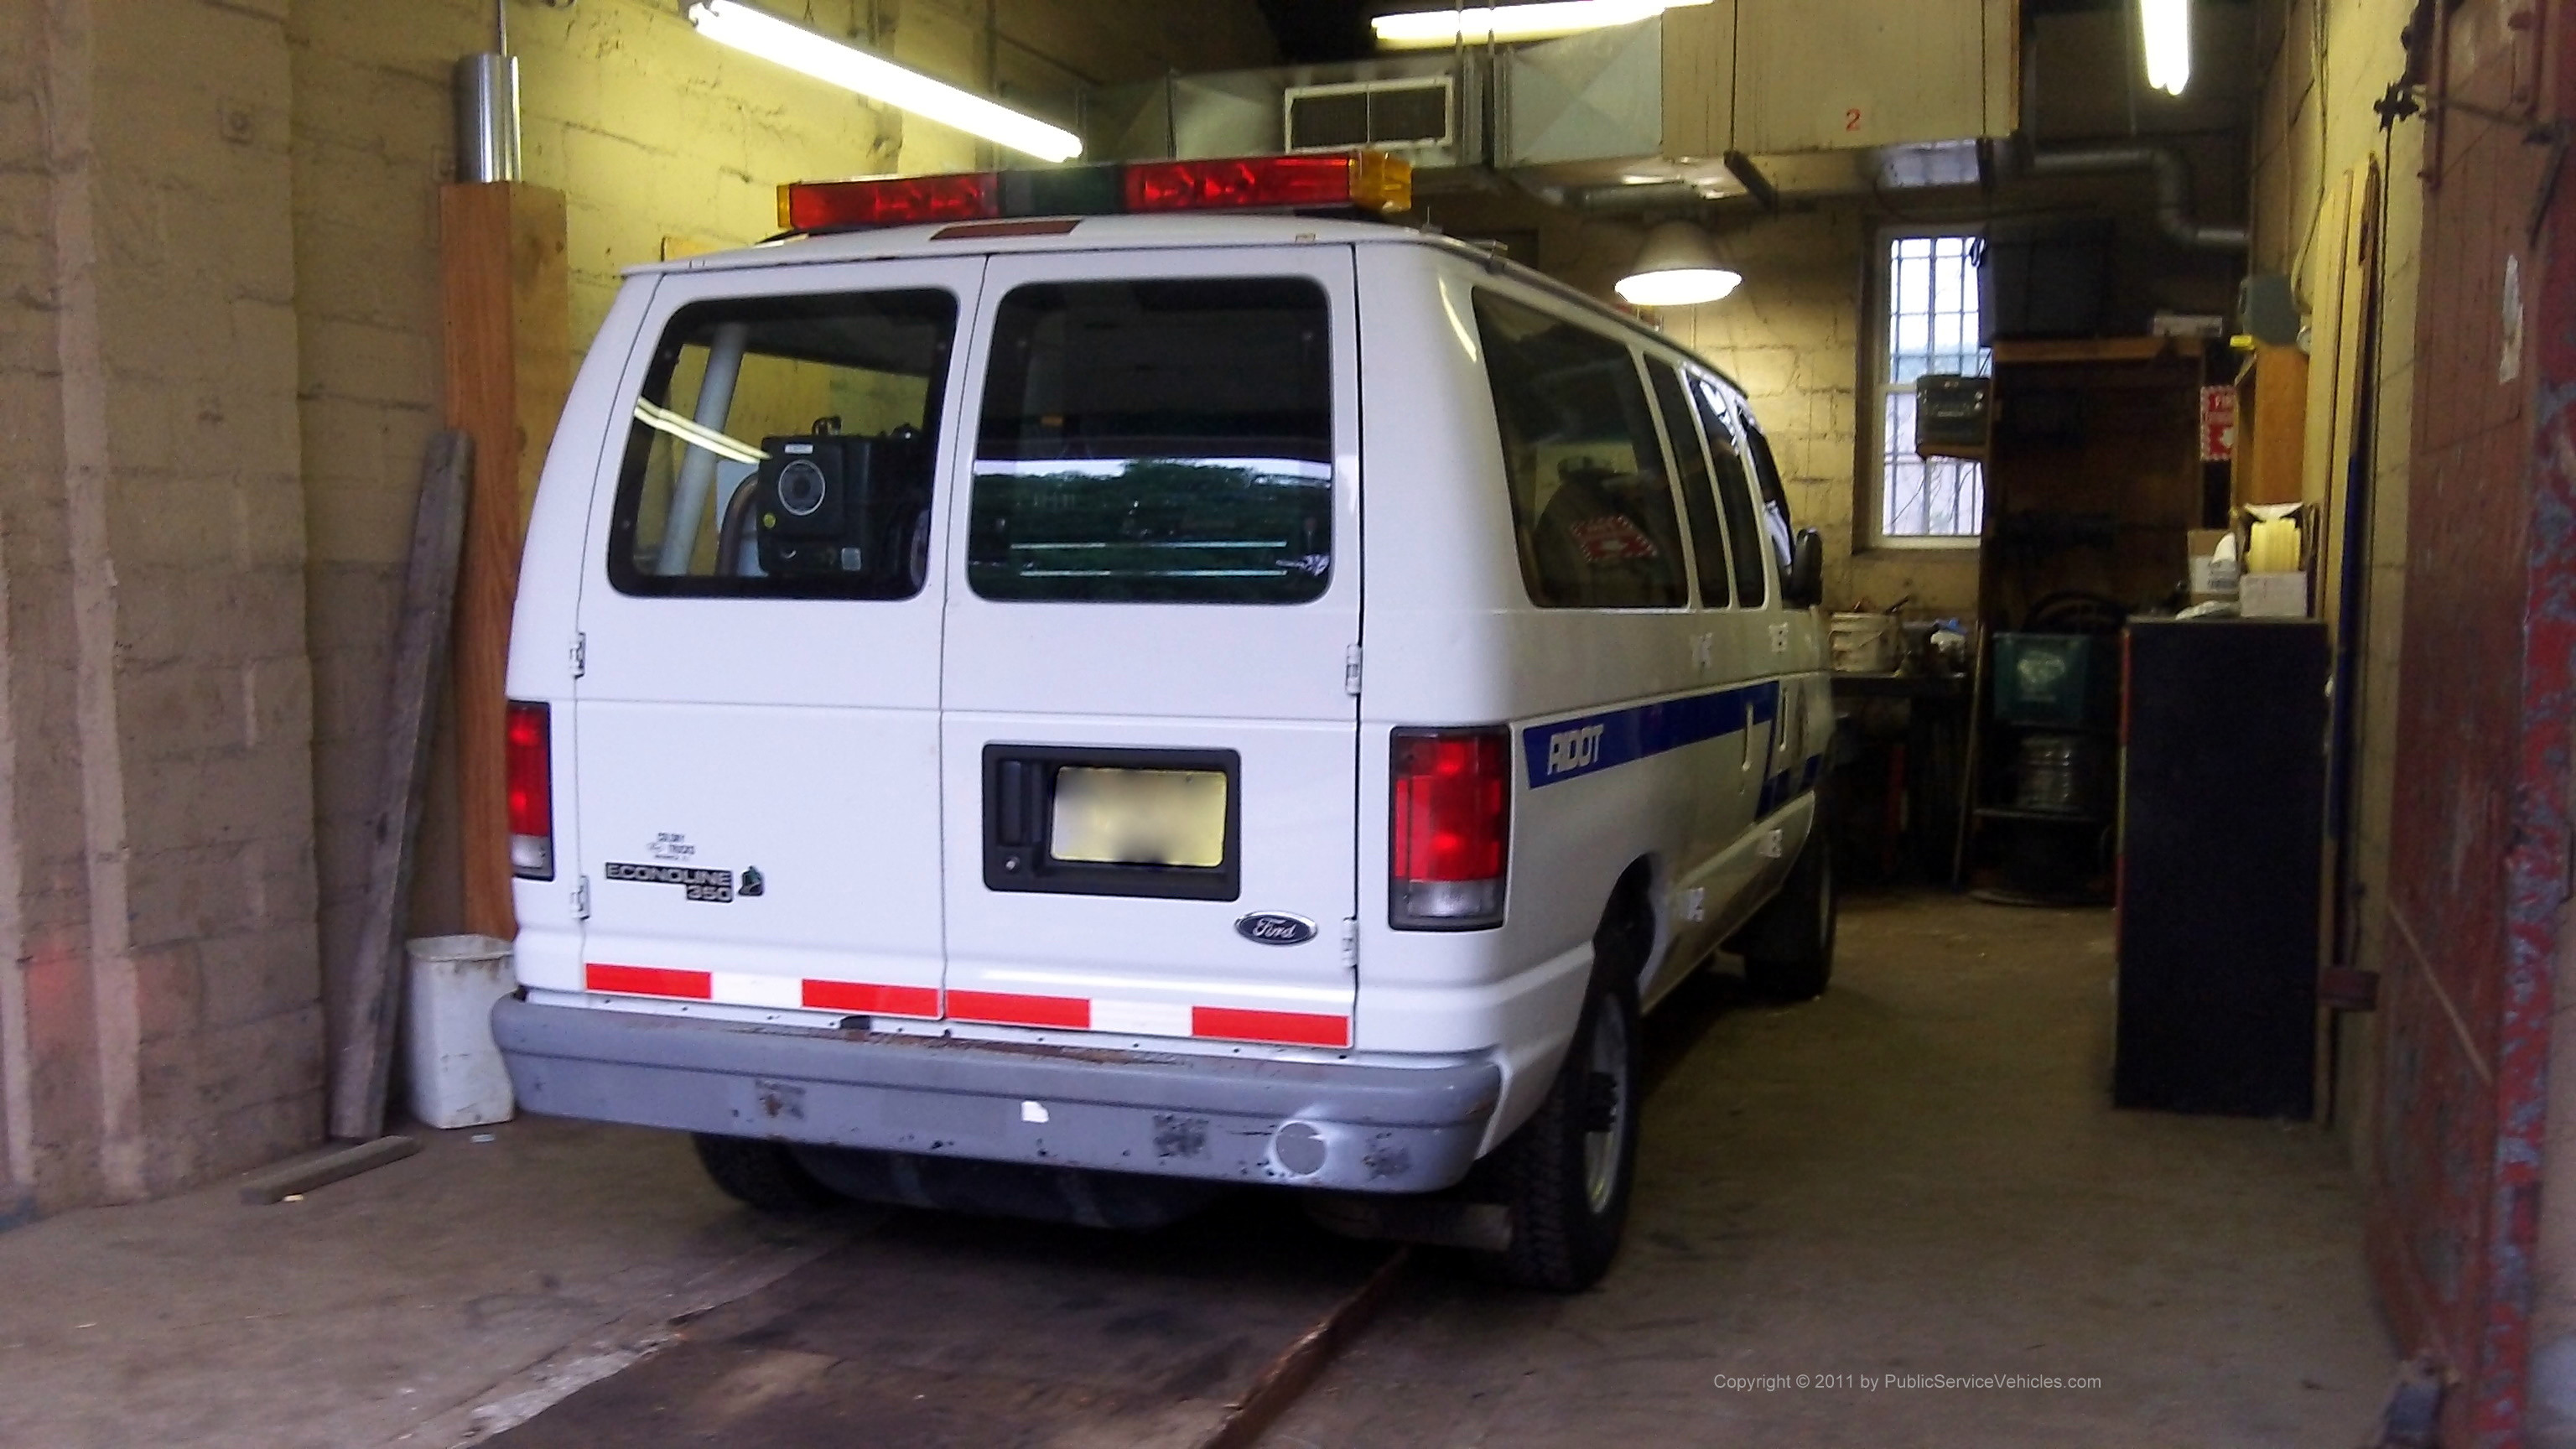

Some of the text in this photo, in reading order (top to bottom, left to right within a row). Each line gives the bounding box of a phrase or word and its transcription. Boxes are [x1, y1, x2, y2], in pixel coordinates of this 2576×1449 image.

[1846, 108, 1861, 131] 2
[607, 865, 730, 886] ECONOLINE
[688, 885, 730, 901] 350
[1252, 917, 1298, 938] Ford
